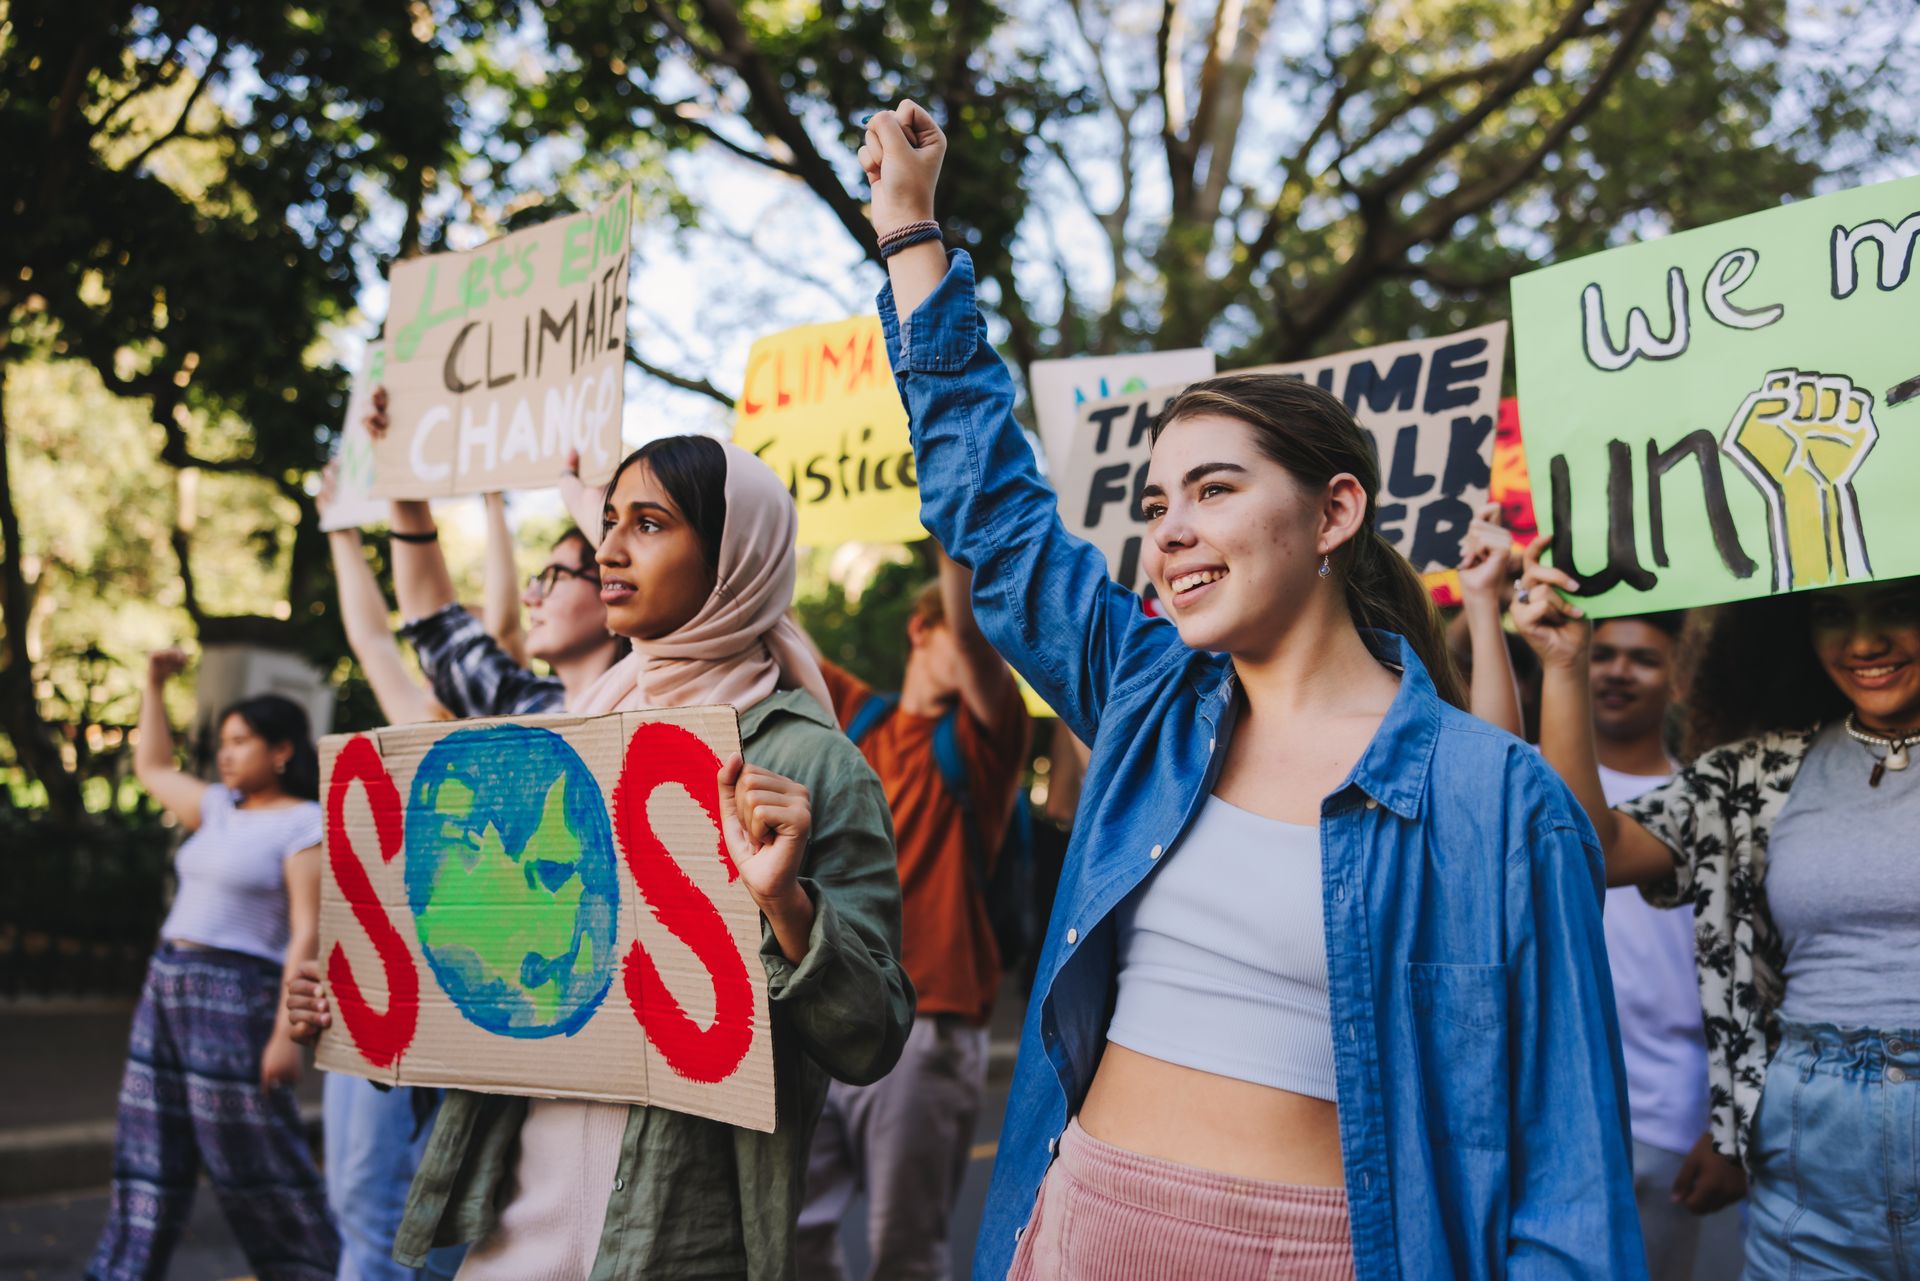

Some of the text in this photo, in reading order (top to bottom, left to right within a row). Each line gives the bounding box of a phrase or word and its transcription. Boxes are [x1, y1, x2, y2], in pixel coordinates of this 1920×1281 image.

[559, 196, 629, 288] END
[443, 255, 627, 393] CLIMATE
[745, 332, 894, 414] CLIMA
[1282, 338, 1489, 417] IME
